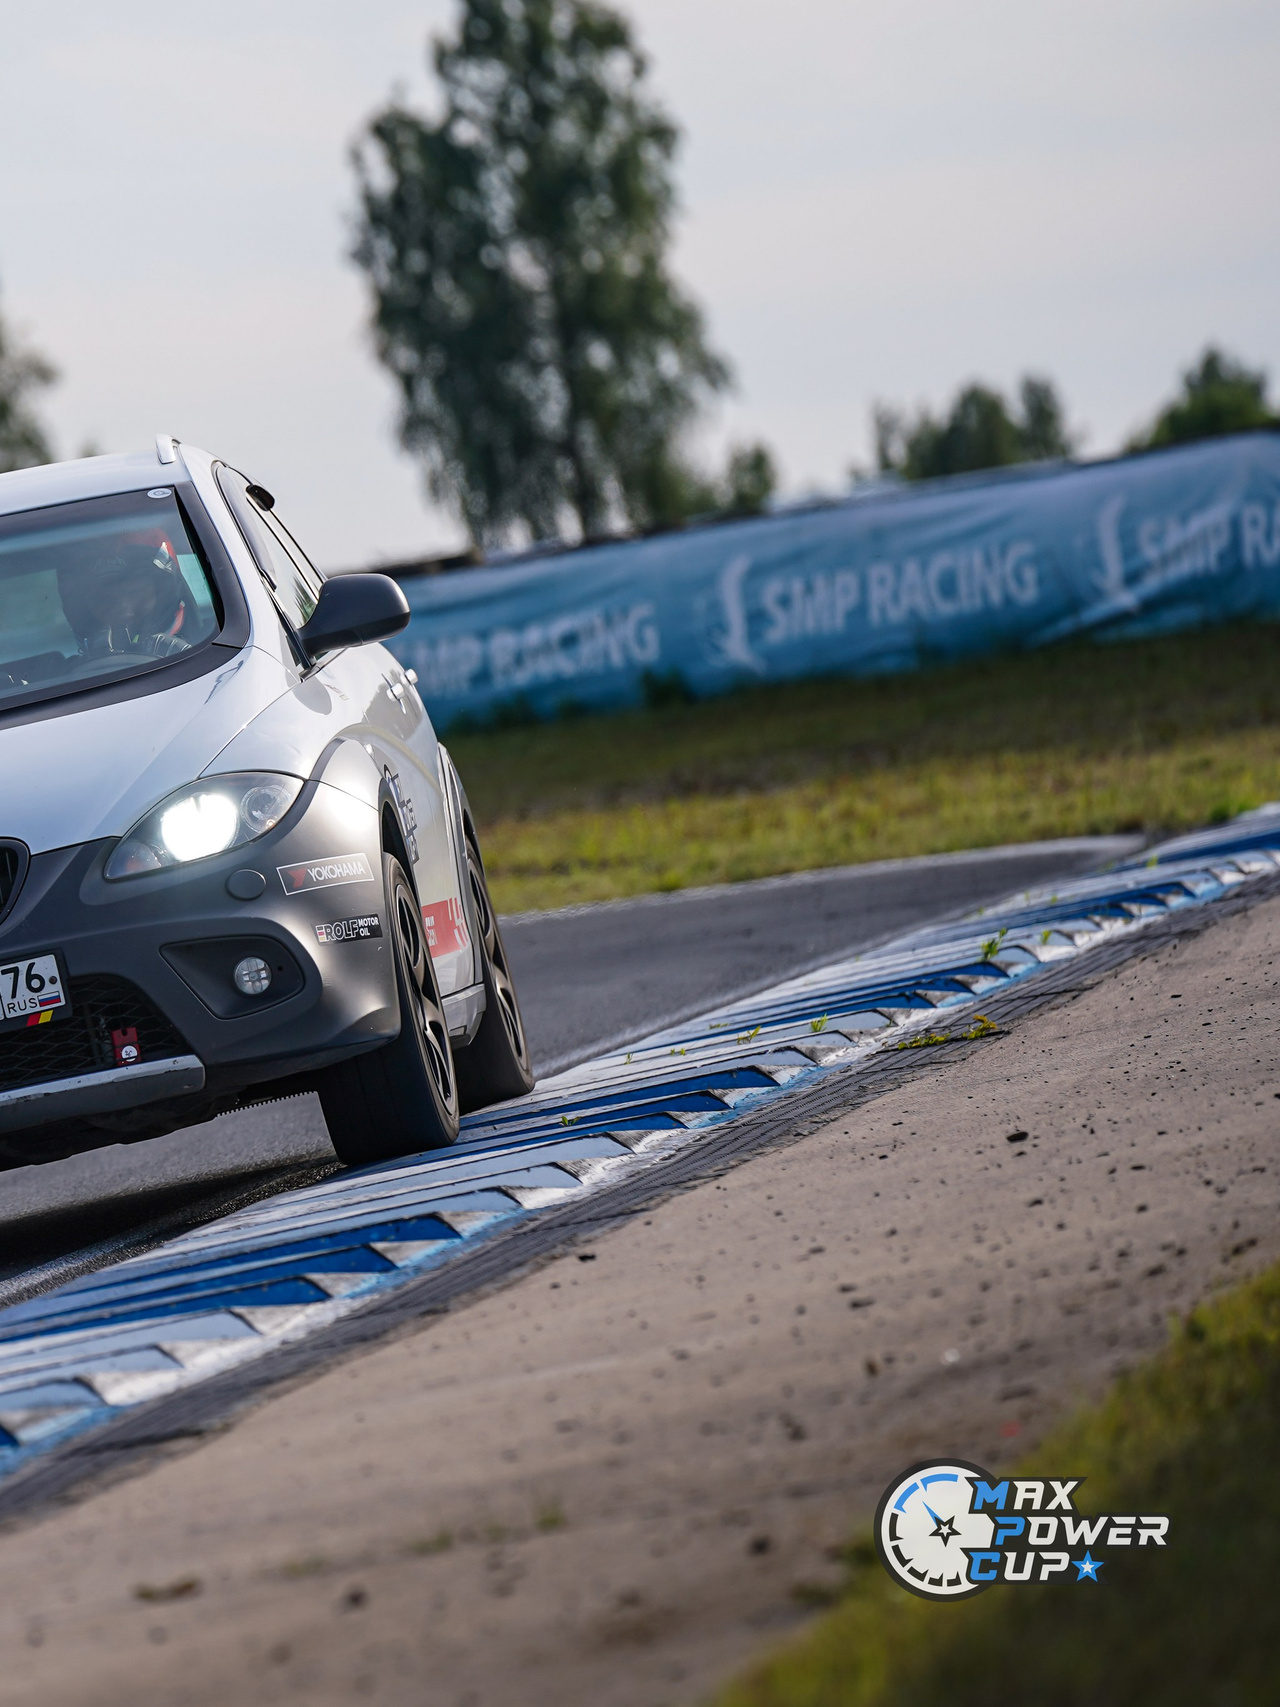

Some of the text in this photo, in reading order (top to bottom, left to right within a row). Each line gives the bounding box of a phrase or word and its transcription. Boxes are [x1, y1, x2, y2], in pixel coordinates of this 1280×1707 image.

[762, 542, 1039, 645] SMP RACING
[397, 603, 660, 695] MP RACING
[308, 861, 366, 882] YOKOHAMA
[324, 919, 359, 941] ROLF
[358, 916, 380, 927] MOTOR
[360, 927, 370, 937] OIL
[1, 962, 45, 999] 76
[7, 998, 38, 1014] RUS
